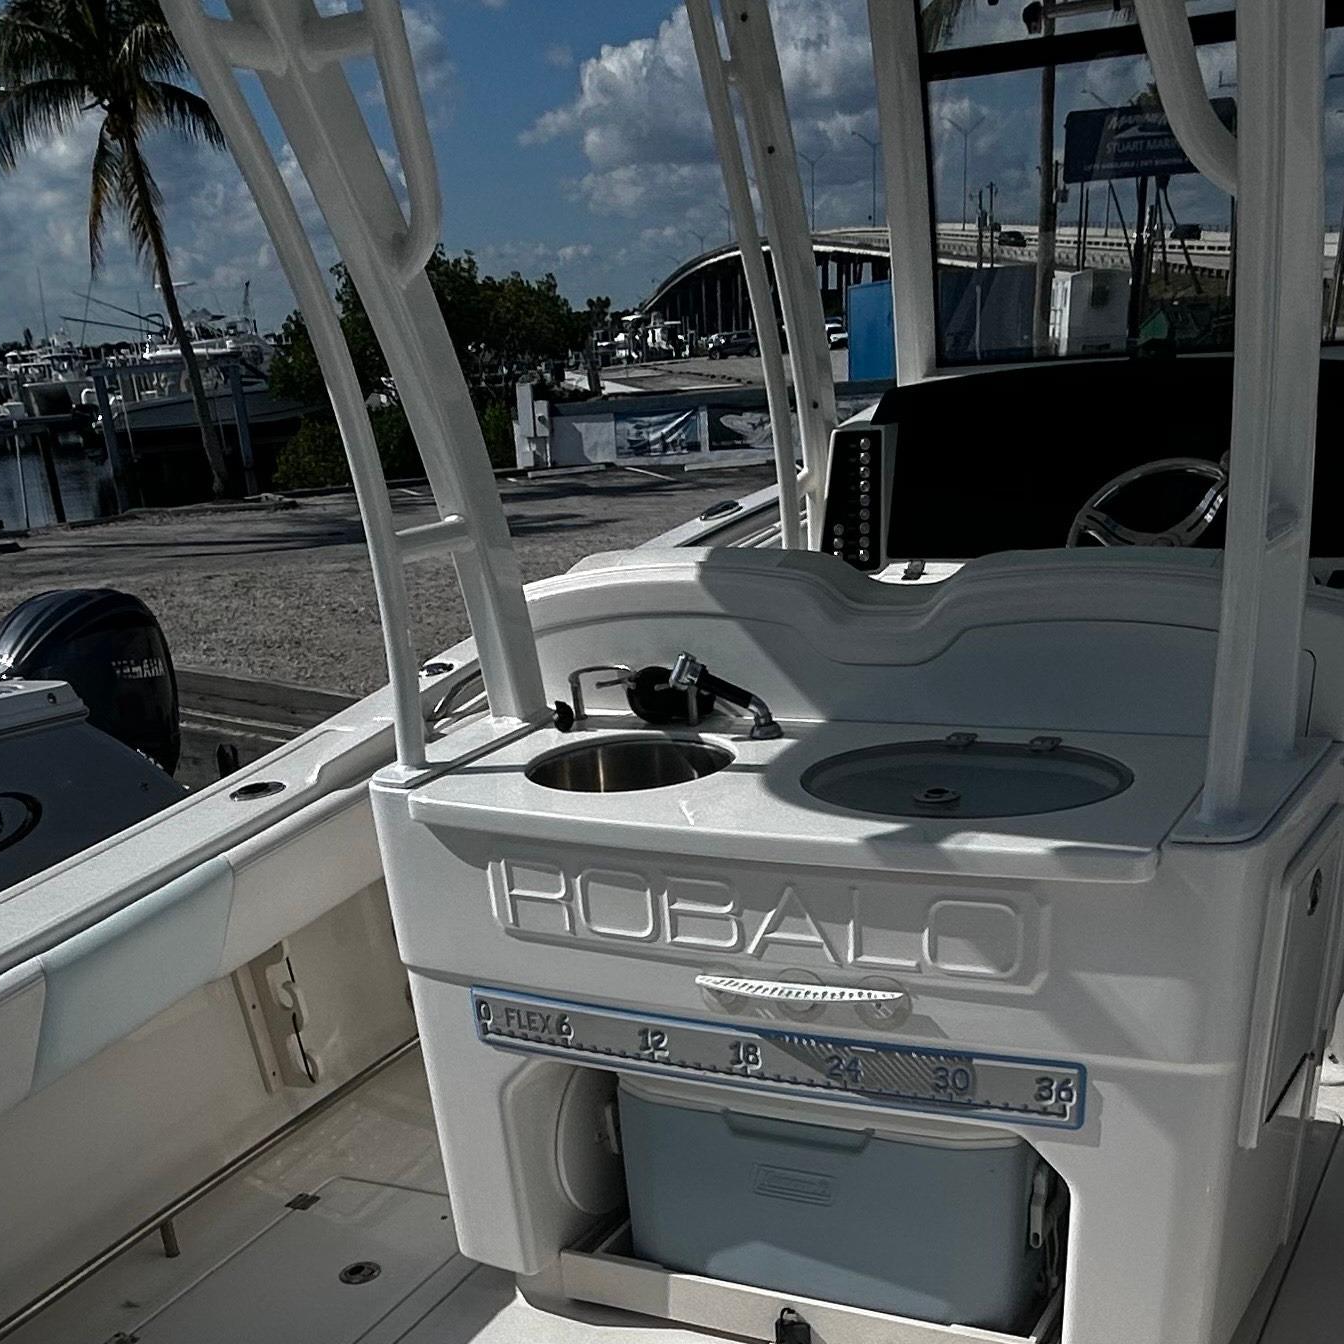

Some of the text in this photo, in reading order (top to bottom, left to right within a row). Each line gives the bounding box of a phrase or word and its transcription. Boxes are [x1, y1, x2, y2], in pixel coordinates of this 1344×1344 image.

[499, 858, 1024, 979] ROBALO
[505, 1008, 553, 1034] FLEX
[557, 1013, 574, 1038] 6
[637, 1027, 668, 1053] 12
[730, 1040, 761, 1068] 18
[824, 1054, 864, 1081] 24
[932, 1066, 971, 1092] 30
[1035, 1077, 1077, 1104] 36
